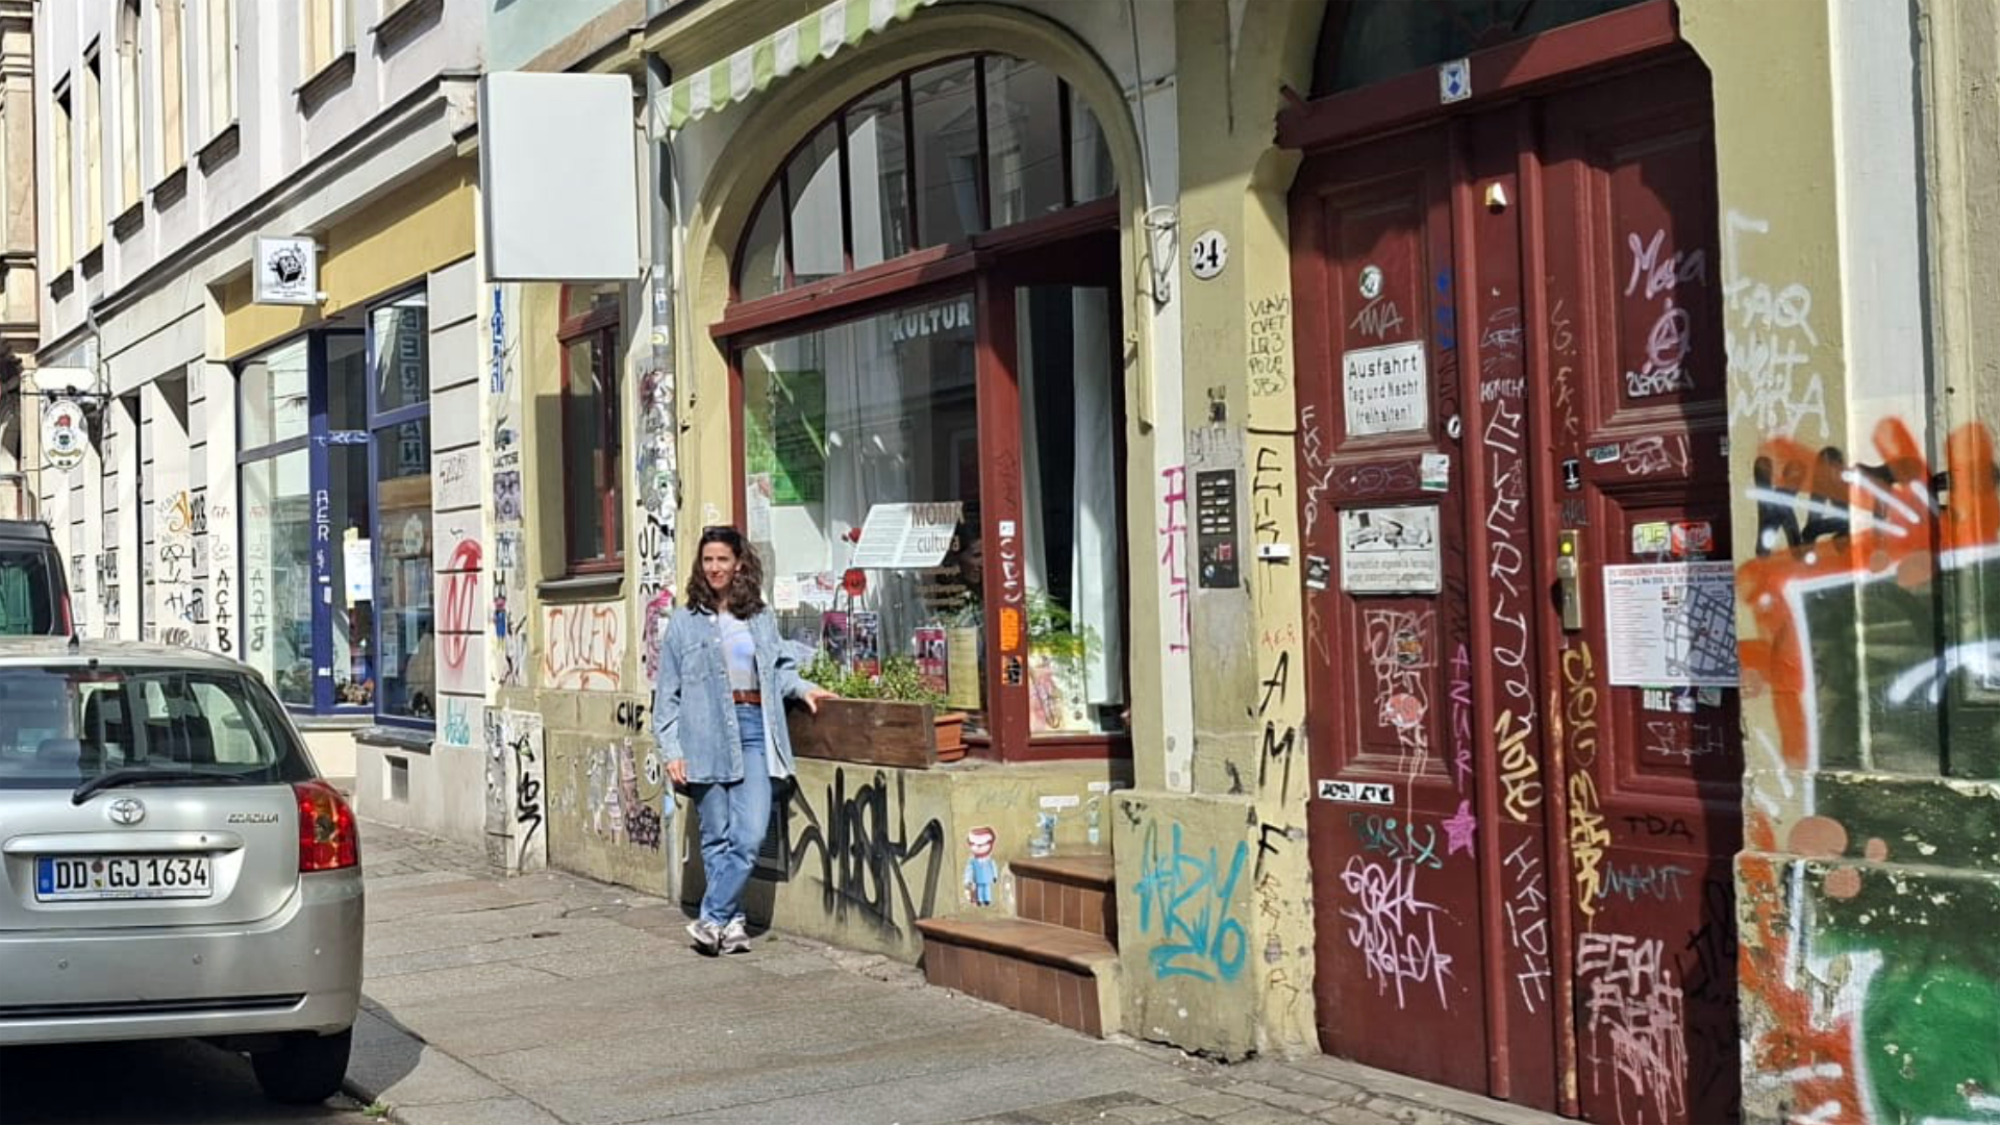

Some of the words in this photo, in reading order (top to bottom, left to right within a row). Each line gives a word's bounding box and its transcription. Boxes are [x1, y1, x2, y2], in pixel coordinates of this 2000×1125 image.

[1194, 238, 1218, 269] 24
[889, 303, 971, 341] KULTUR
[1348, 353, 1417, 380] Ausfahrt
[1388, 379, 1418, 398] Nacht
[56, 862, 88, 889] DD
[108, 860, 140, 888] GJ
[147, 857, 208, 887] 1634
